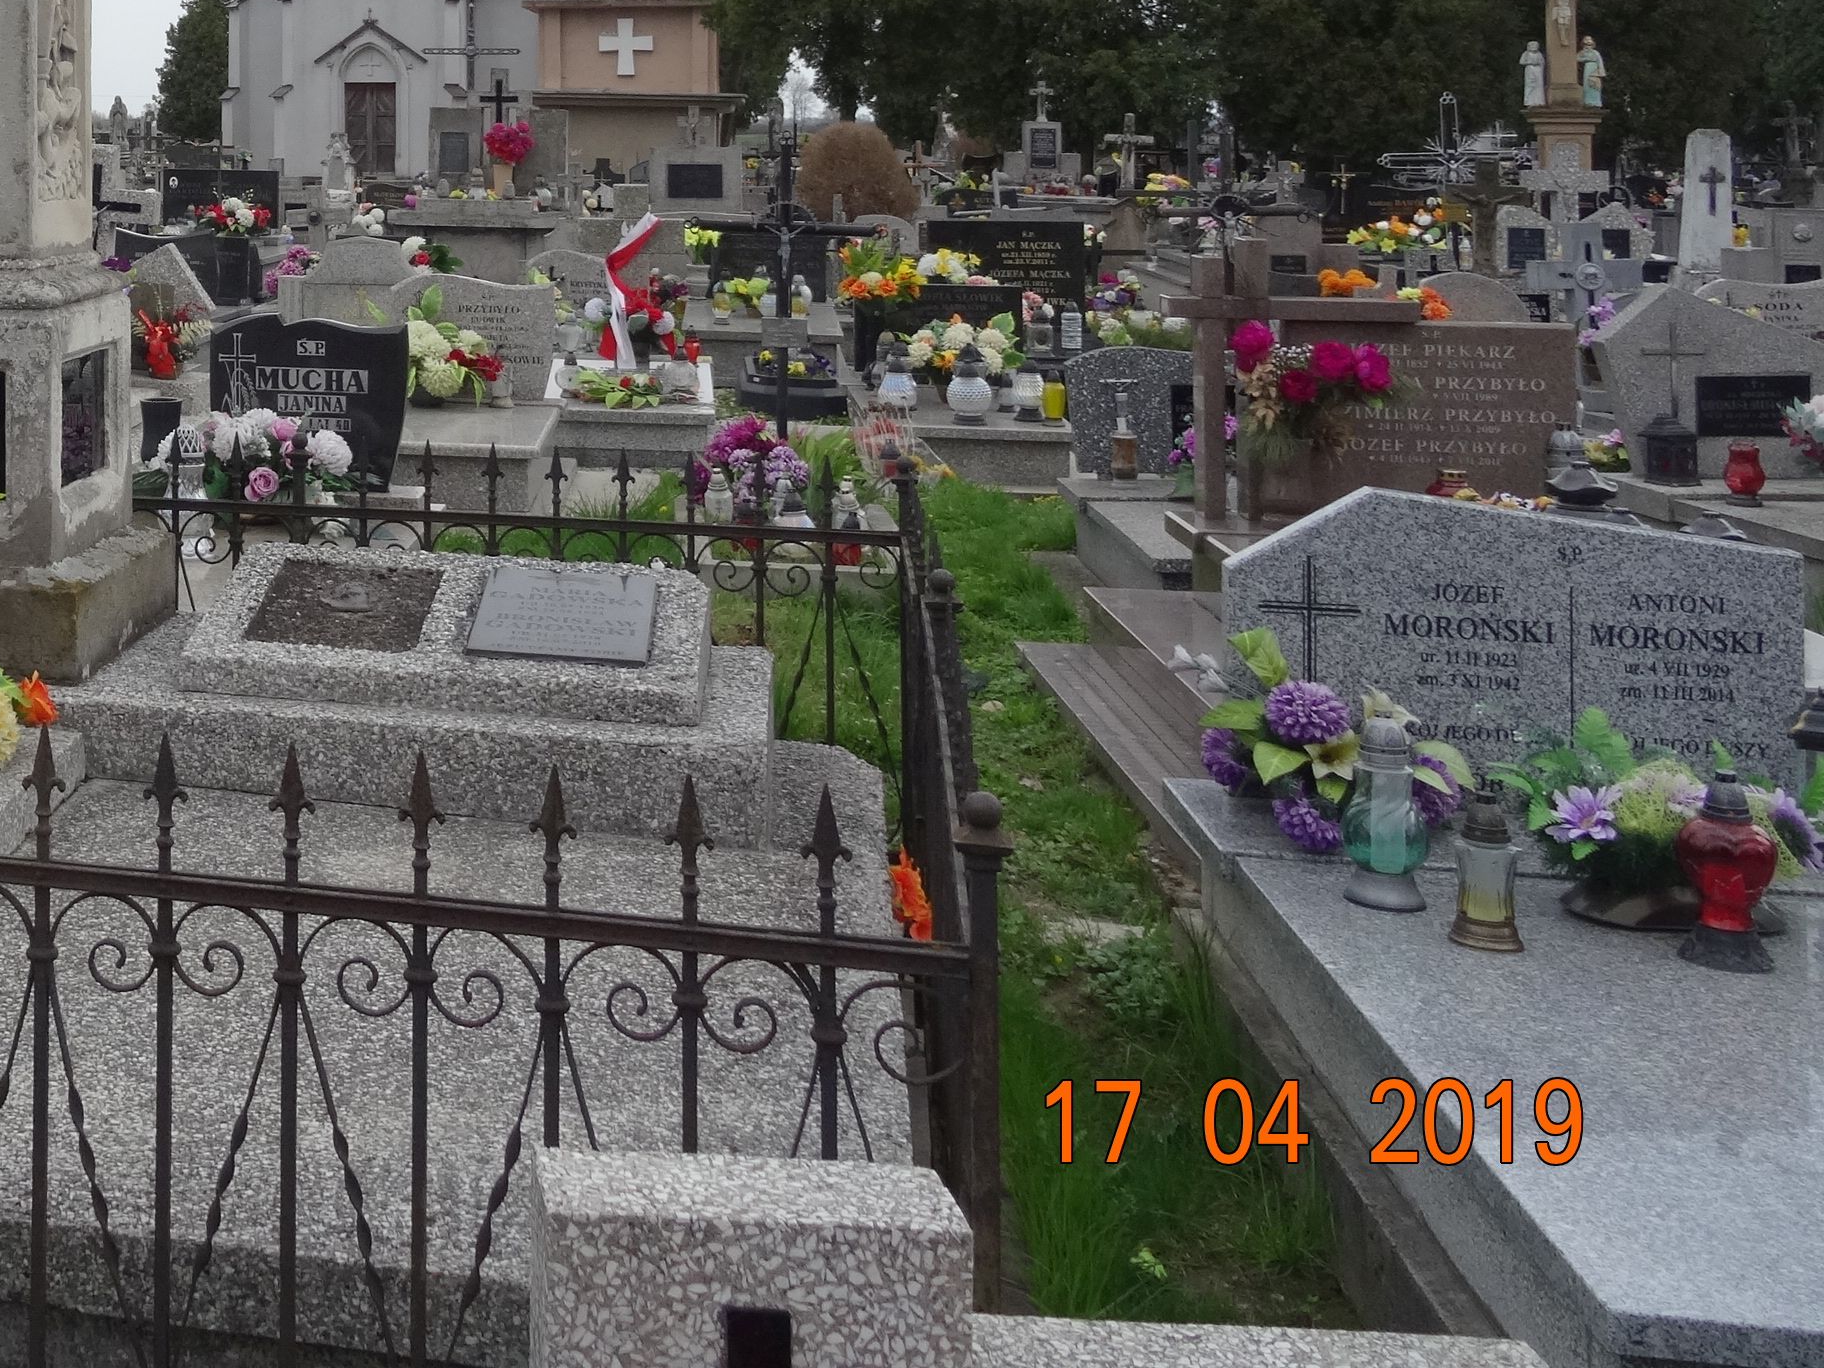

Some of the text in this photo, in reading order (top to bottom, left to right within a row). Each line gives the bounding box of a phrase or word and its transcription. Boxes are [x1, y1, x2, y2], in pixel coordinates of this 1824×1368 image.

[995, 240, 1062, 251] JAN MĄCZKA
[988, 268, 1072, 279] JÓZEFA MĄCZKA
[1753, 302, 1804, 312] SODA
[1424, 343, 1517, 360] PIEKARZ
[256, 367, 367, 393] MUCHA
[1434, 376, 1547, 393] PRZYBYŁO
[278, 395, 345, 413] JANINA
[1445, 408, 1557, 425] PRZYBYŁO
[1415, 439, 1528, 456] PRZYBYŁO
[489, 590, 644, 607] GADOWSKA
[531, 586, 607, 597] MARIA
[1626, 593, 1727, 615] ANTONI
[484, 619, 637, 636] GADOWSKI
[496, 612, 637, 627] BRONISŁAW
[1419, 651, 1440, 663] ur.
[1484, 652, 1518, 667] 1923
[1623, 661, 1731, 678] ur. 4 VII 1929
[1417, 675, 1444, 687] zm.
[1487, 676, 1522, 691] 1942
[1619, 686, 1646, 699] zm.
[1697, 686, 1736, 702] 2014
[1443, 725, 1491, 742] JEGO
